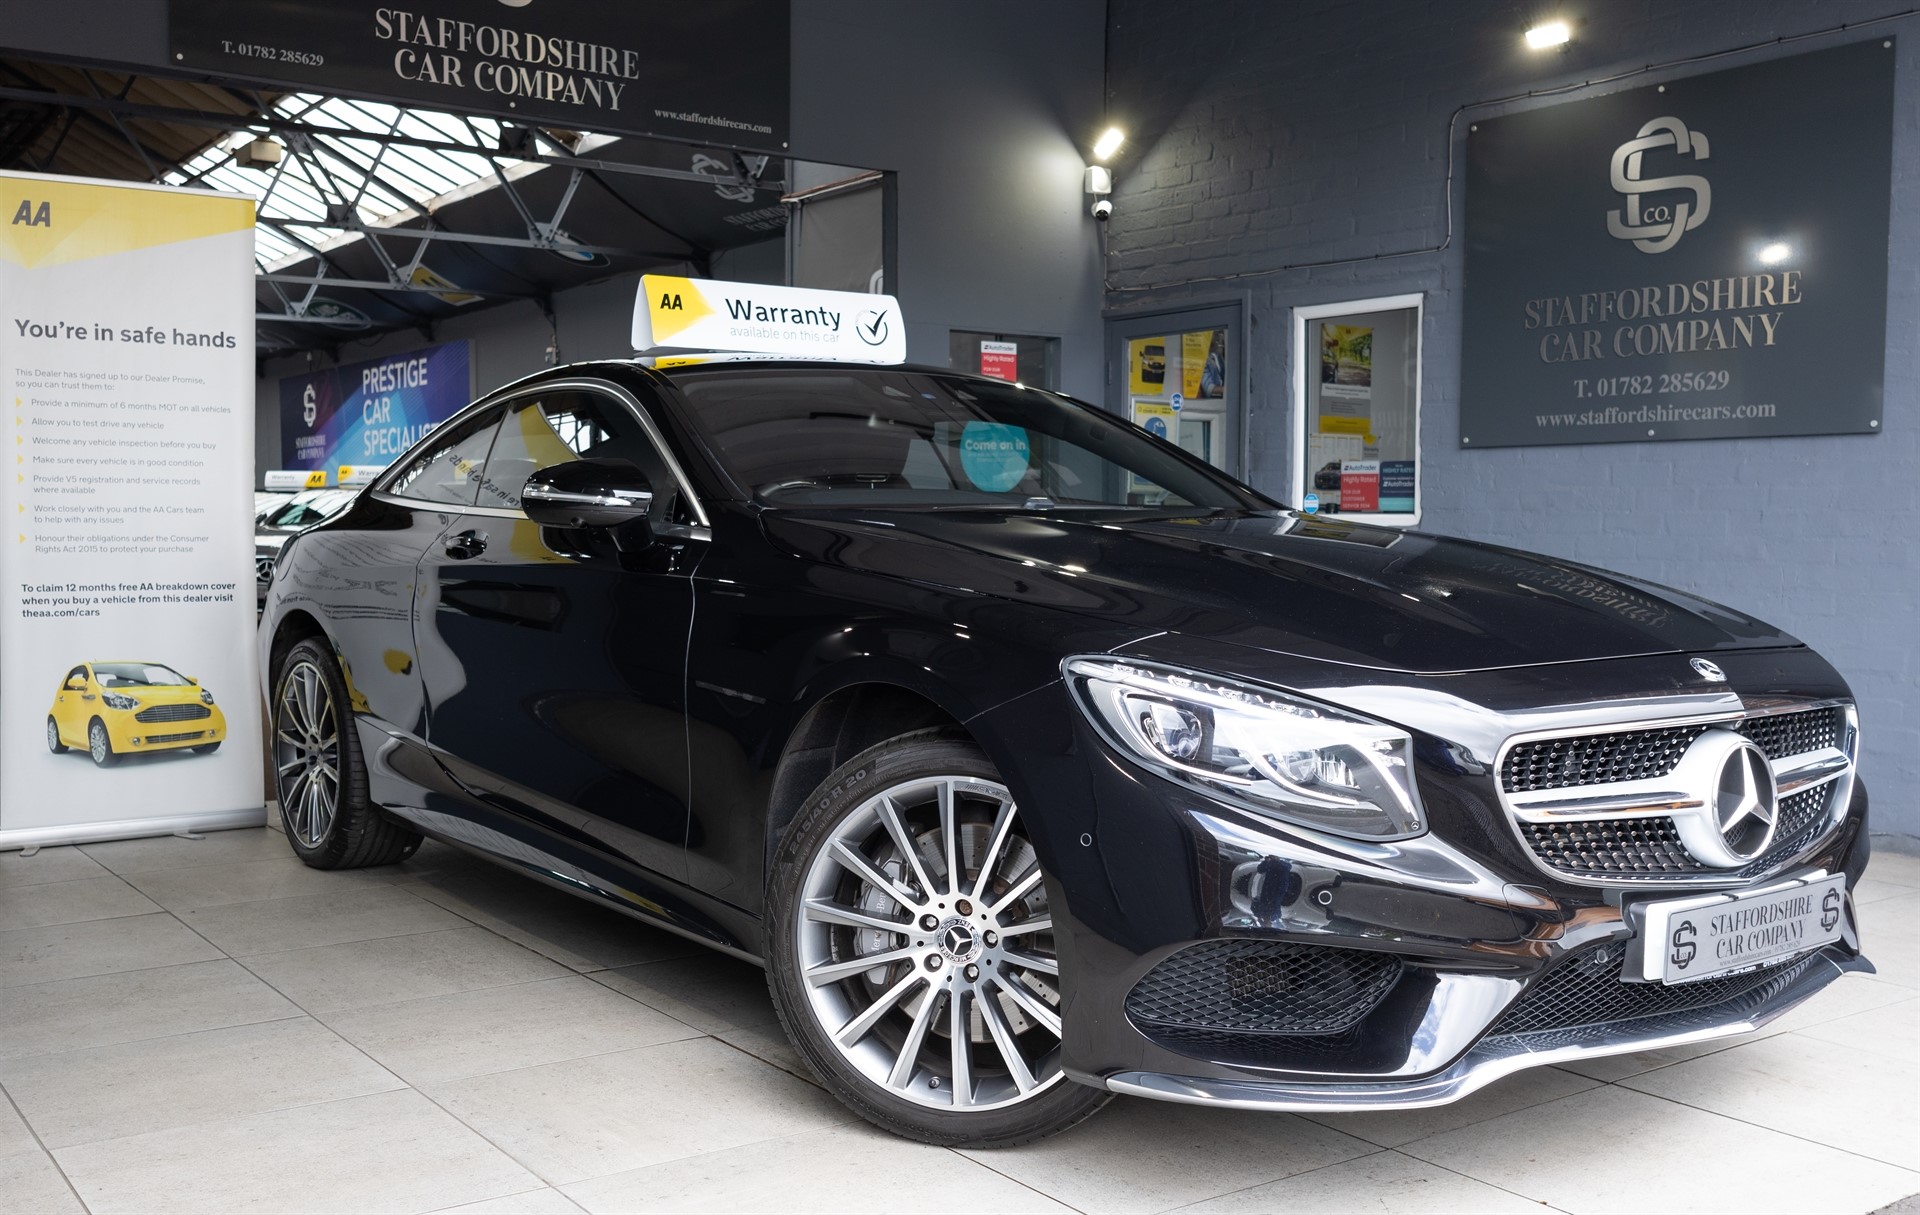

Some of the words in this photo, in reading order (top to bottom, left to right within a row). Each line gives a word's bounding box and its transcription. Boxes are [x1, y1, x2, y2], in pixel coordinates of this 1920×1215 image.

[222, 40, 236, 54] T.
[238, 42, 277, 60] 01782
[279, 48, 324, 67] 285629
[375, 8, 640, 80] STAFFORDSHIRE
[394, 48, 465, 88] CAR
[473, 61, 626, 111] COMPANY
[654, 109, 772, 134] www.staffordshirecars.com
[12, 200, 52, 227] AA
[1524, 270, 1802, 330] STAFFORDSHIRE
[660, 293, 683, 310] AA
[725, 298, 840, 331] Warranty
[94, 323, 113, 342] in
[120, 326, 166, 345] safe
[172, 327, 236, 349] hands
[730, 326, 780, 340] available
[783, 330, 797, 341] on
[800, 330, 820, 341] this
[823, 333, 840, 343] car
[1540, 329, 1605, 363] CAR
[1613, 312, 1784, 358] COMPANY
[362, 358, 428, 395] PRESTIGE
[1574, 379, 1592, 398] T.
[1597, 375, 1653, 397] 01782
[1659, 370, 1730, 394] 285629
[30, 398, 63, 408] Provide
[63, 400, 70, 408] a
[70, 400, 108, 409] minimum
[109, 401, 119, 409] of
[119, 401, 126, 410] 6
[127, 402, 157, 411] months
[158, 403, 178, 412] MOT
[190, 404, 200, 413] all
[200, 405, 231, 414] vehicles
[362, 396, 391, 425] CAR
[1535, 403, 1777, 428] www.staffordshirecars.com
[31, 417, 55, 426] Allow
[55, 418, 72, 428] you
[72, 419, 81, 427] to
[82, 419, 98, 429] test
[99, 419, 120, 428] drive
[121, 421, 136, 430] any
[136, 420, 165, 430] vehicle
[31, 436, 71, 446] Welcome
[72, 439, 87, 448] any
[87, 438, 117, 447] vehicle
[118, 439, 159, 448] inspection
[159, 440, 186, 449] before
[186, 442, 201, 450] you
[202, 441, 216, 450] buy
[965, 439, 997, 450] Come
[999, 441, 1014, 450] on
[1015, 439, 1026, 450] in
[32, 455, 55, 464] Make
[56, 457, 75, 465] sure
[75, 457, 98, 466] every
[99, 457, 128, 466] vehicle
[129, 458, 137, 466] is
[137, 457, 145, 466] in
[145, 458, 167, 468] good
[167, 459, 204, 467] condition
[310, 475, 322, 484] AA
[33, 504, 57, 514] Work
[57, 504, 86, 515] closely
[86, 505, 105, 513] with
[106, 506, 121, 515] you
[122, 505, 138, 513] and
[138, 505, 152, 514] the
[152, 505, 165, 513] AA
[165, 505, 184, 514] Cars
[185, 506, 205, 514] team
[33, 515, 43, 524] to
[44, 515, 63, 525] help
[63, 515, 82, 524] with
[82, 516, 98, 525] any
[98, 515, 125, 524] issues
[34, 534, 66, 543] Honour
[66, 534, 85, 543] their
[86, 534, 130, 544] obligations
[131, 535, 154, 543] under
[169, 534, 209, 543] Consumer
[34, 545, 61, 554] Rights
[62, 545, 76, 553] Act
[77, 544, 98, 553] 2015
[99, 545, 109, 553] to
[109, 545, 138, 554] protect
[139, 545, 157, 554] your
[157, 545, 194, 554] purchase
[21, 583, 34, 593] To
[35, 583, 64, 593] claim
[65, 583, 77, 592] 12
[78, 583, 116, 592] months
[118, 582, 138, 592] free
[139, 582, 154, 591] AA
[155, 582, 209, 591] breakdown
[21, 596, 50, 605] when
[51, 597, 70, 606] you
[72, 595, 91, 606] buy
[100, 594, 136, 604] vehicle
[138, 594, 161, 603] from
[162, 594, 181, 603] this
[182, 593, 213, 603] dealer
[214, 593, 233, 602] visit
[22, 607, 100, 618] theaa.com/cars
[845, 769, 867, 789] 20
[1710, 895, 1813, 937] STAFFORDSHIRE
[1716, 935, 1743, 959] CAR
[1748, 919, 1806, 951] COMPANY
